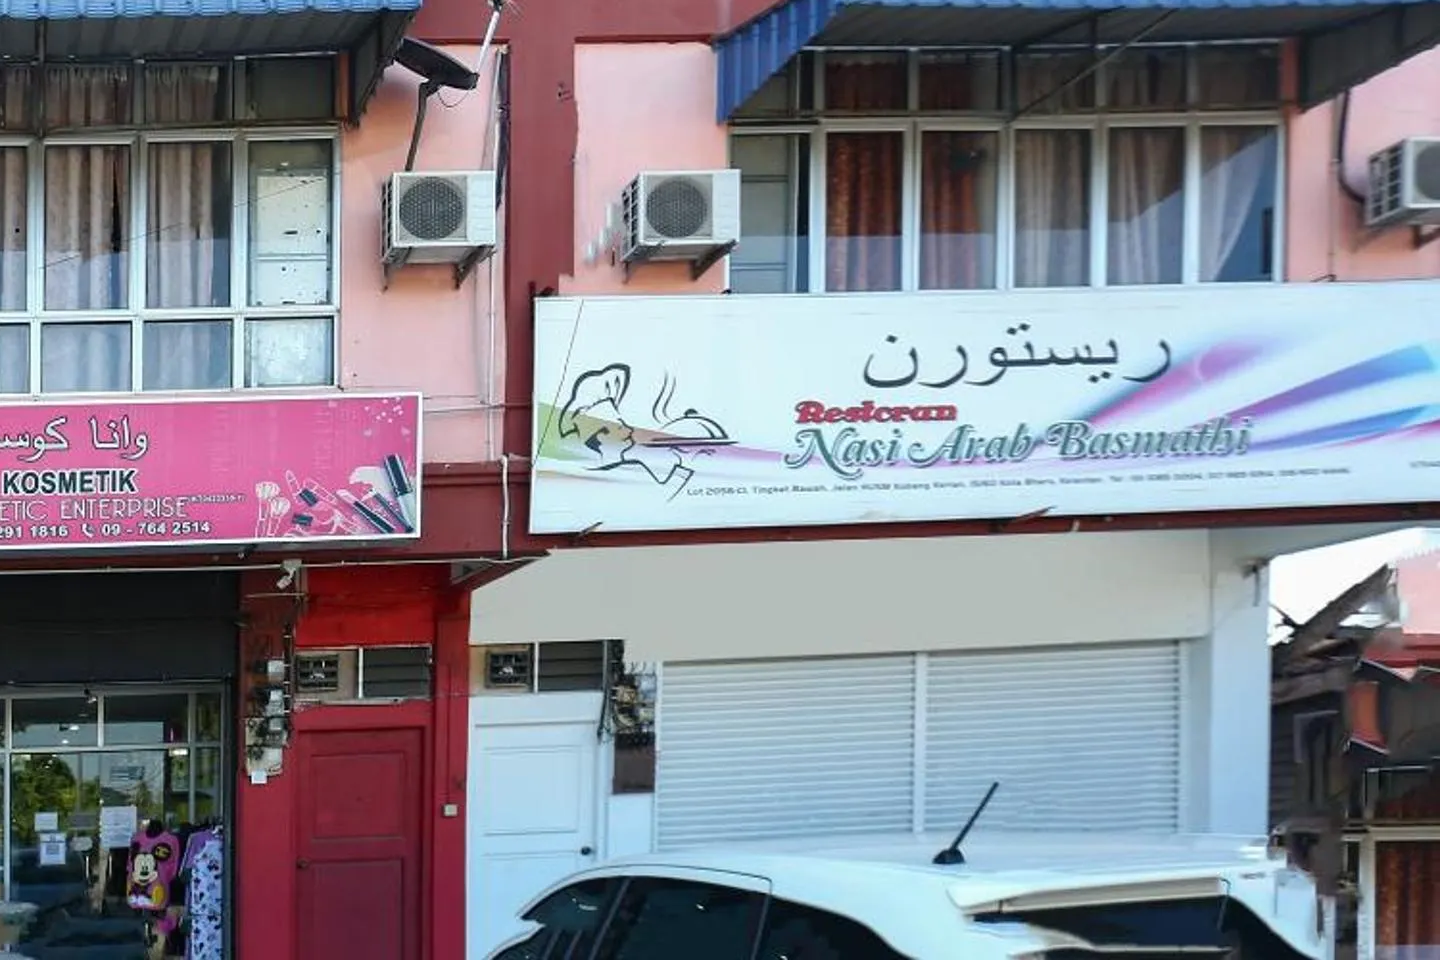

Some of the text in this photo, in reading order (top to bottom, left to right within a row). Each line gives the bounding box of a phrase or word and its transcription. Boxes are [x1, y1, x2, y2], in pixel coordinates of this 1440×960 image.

[863, 323, 1171, 388] ريستورن
[89, 415, 149, 459] وانا
[784, 414, 1255, 480] Nasi Arab Basmathi
[2, 468, 138, 495] KOSMETIK
[61, 496, 187, 520] ENTERPRISE
[30, 525, 68, 537] 1816
[101, 524, 121, 536] 09
[137, 523, 166, 535] 764
[172, 522, 210, 534] 2514
